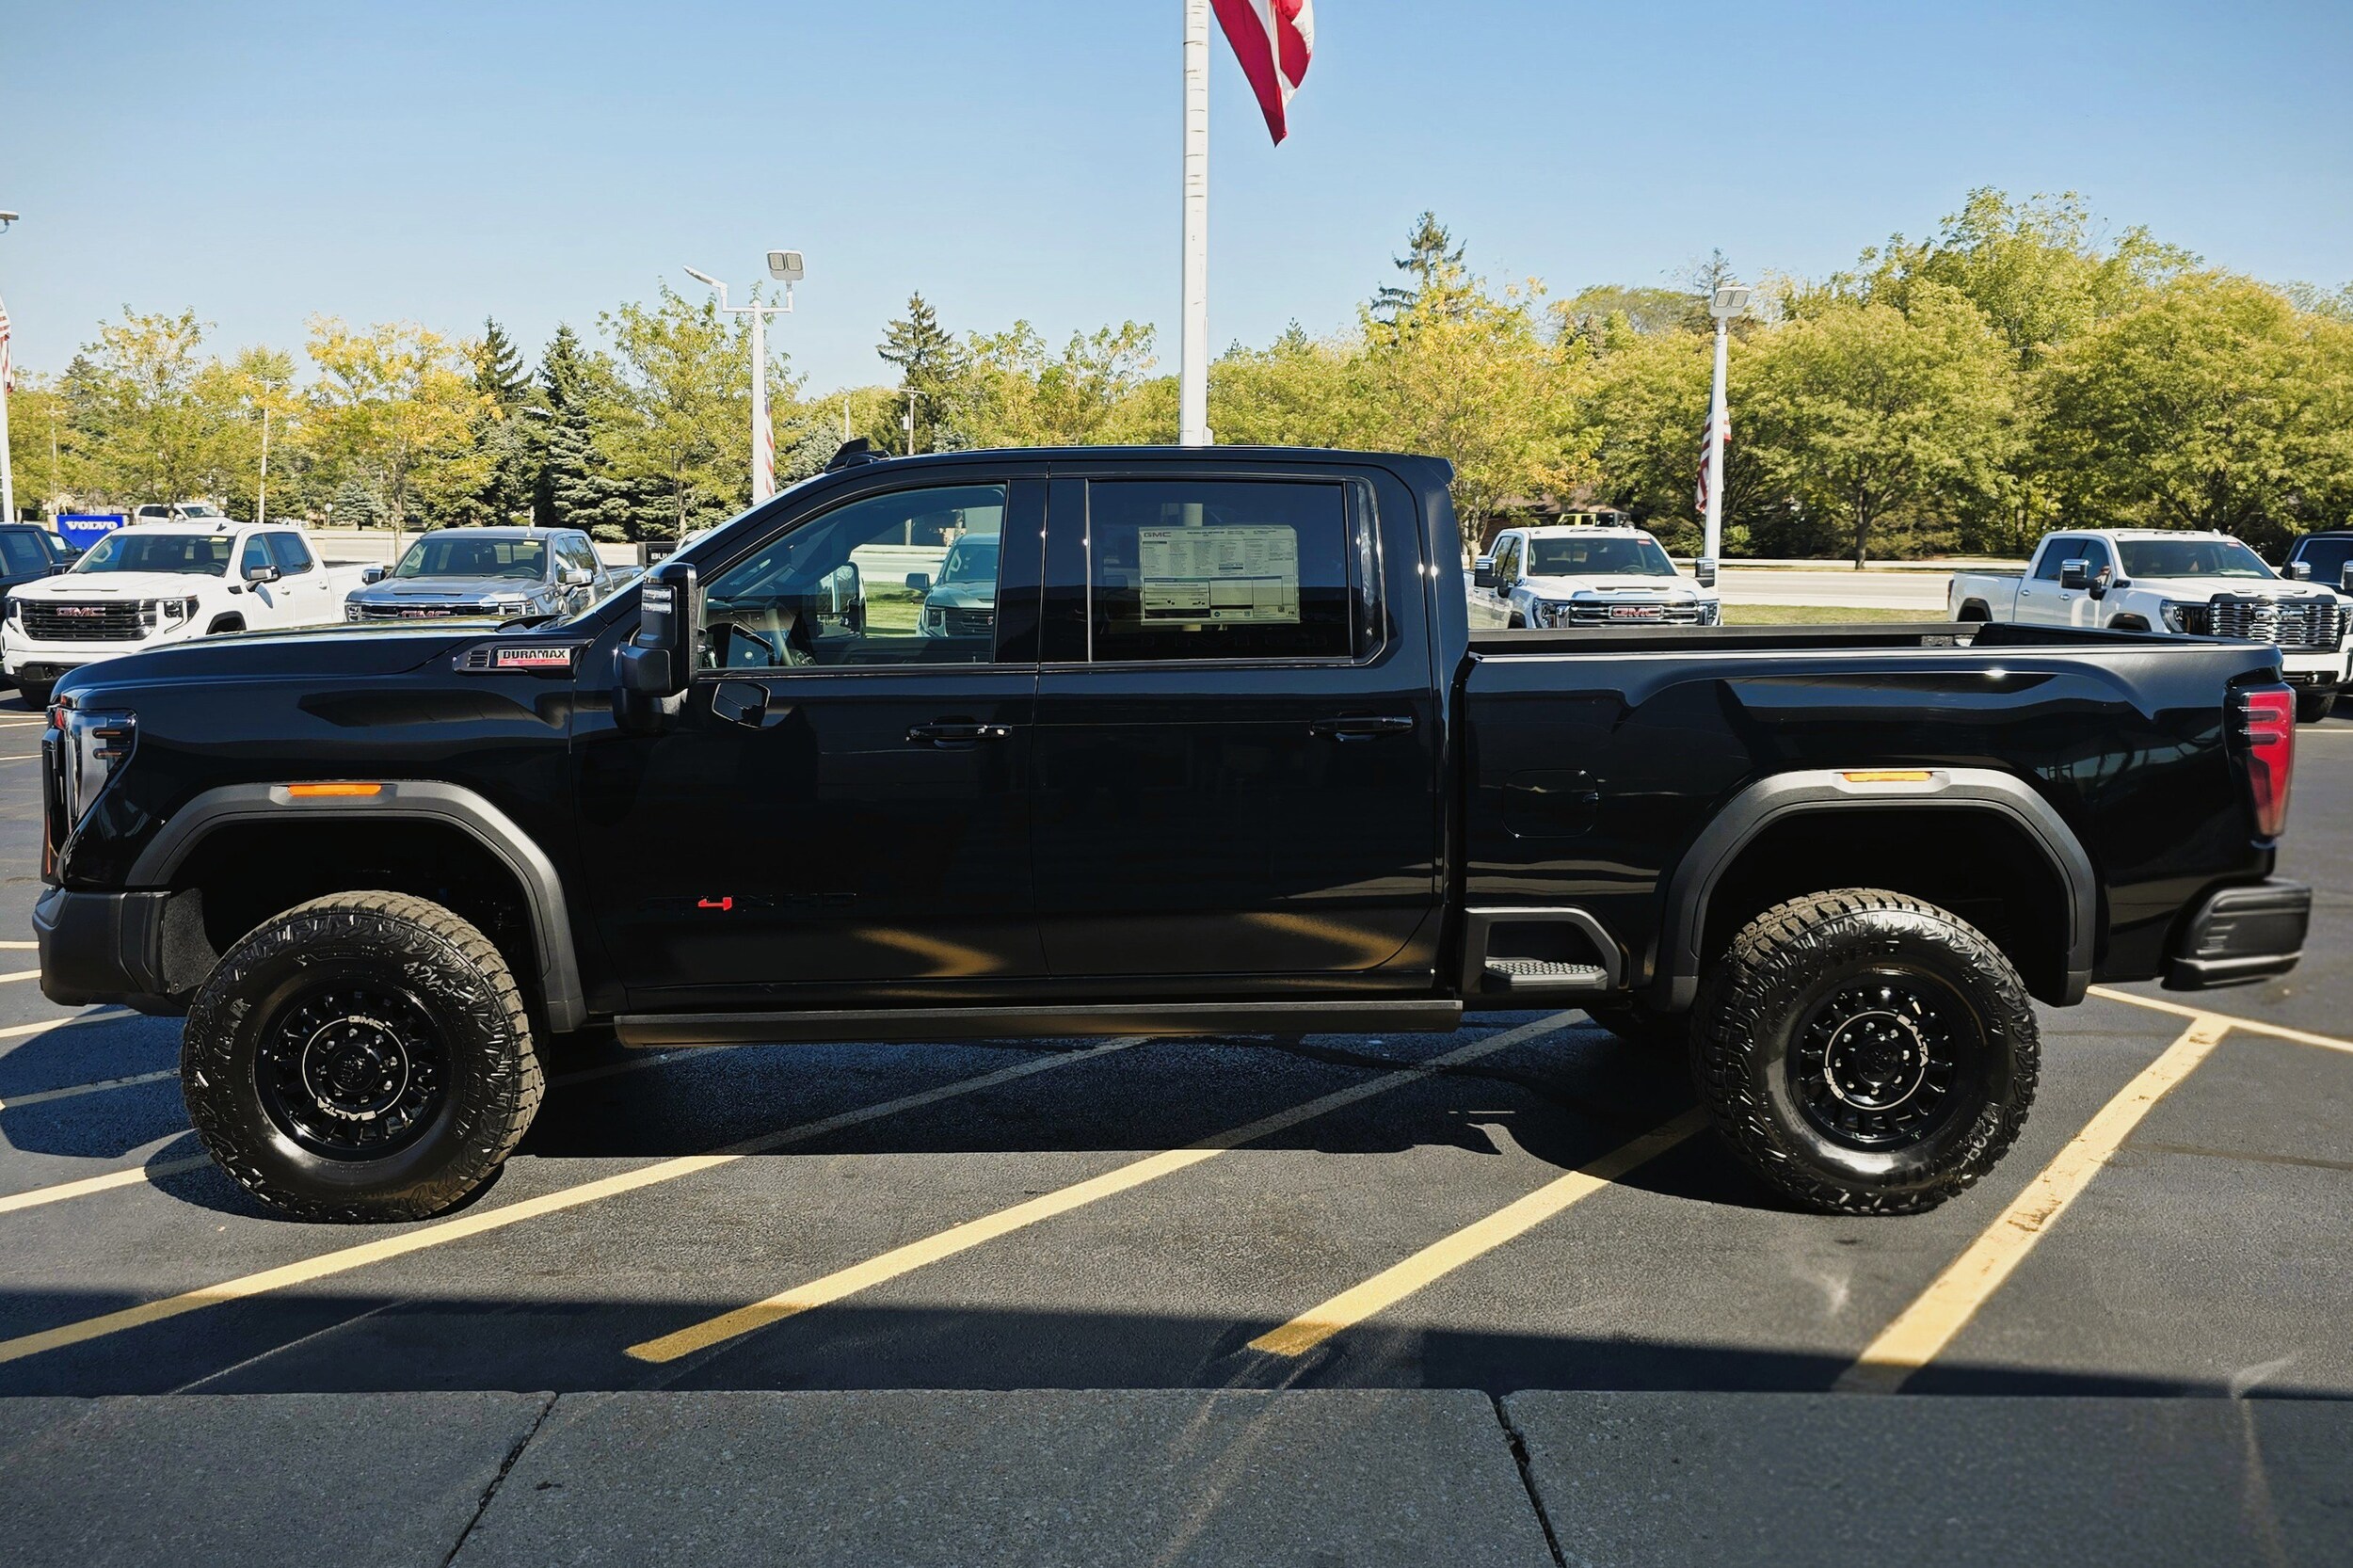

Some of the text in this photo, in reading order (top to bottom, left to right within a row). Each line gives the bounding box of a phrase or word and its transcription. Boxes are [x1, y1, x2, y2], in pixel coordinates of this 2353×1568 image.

[65, 520, 119, 530] VOLVO
[56, 607, 105, 617] GMC
[1612, 607, 1661, 617] GMC
[2255, 610, 2304, 620] GMC
[503, 650, 566, 659] DURAMAX
[348, 1015, 385, 1032] GMC
